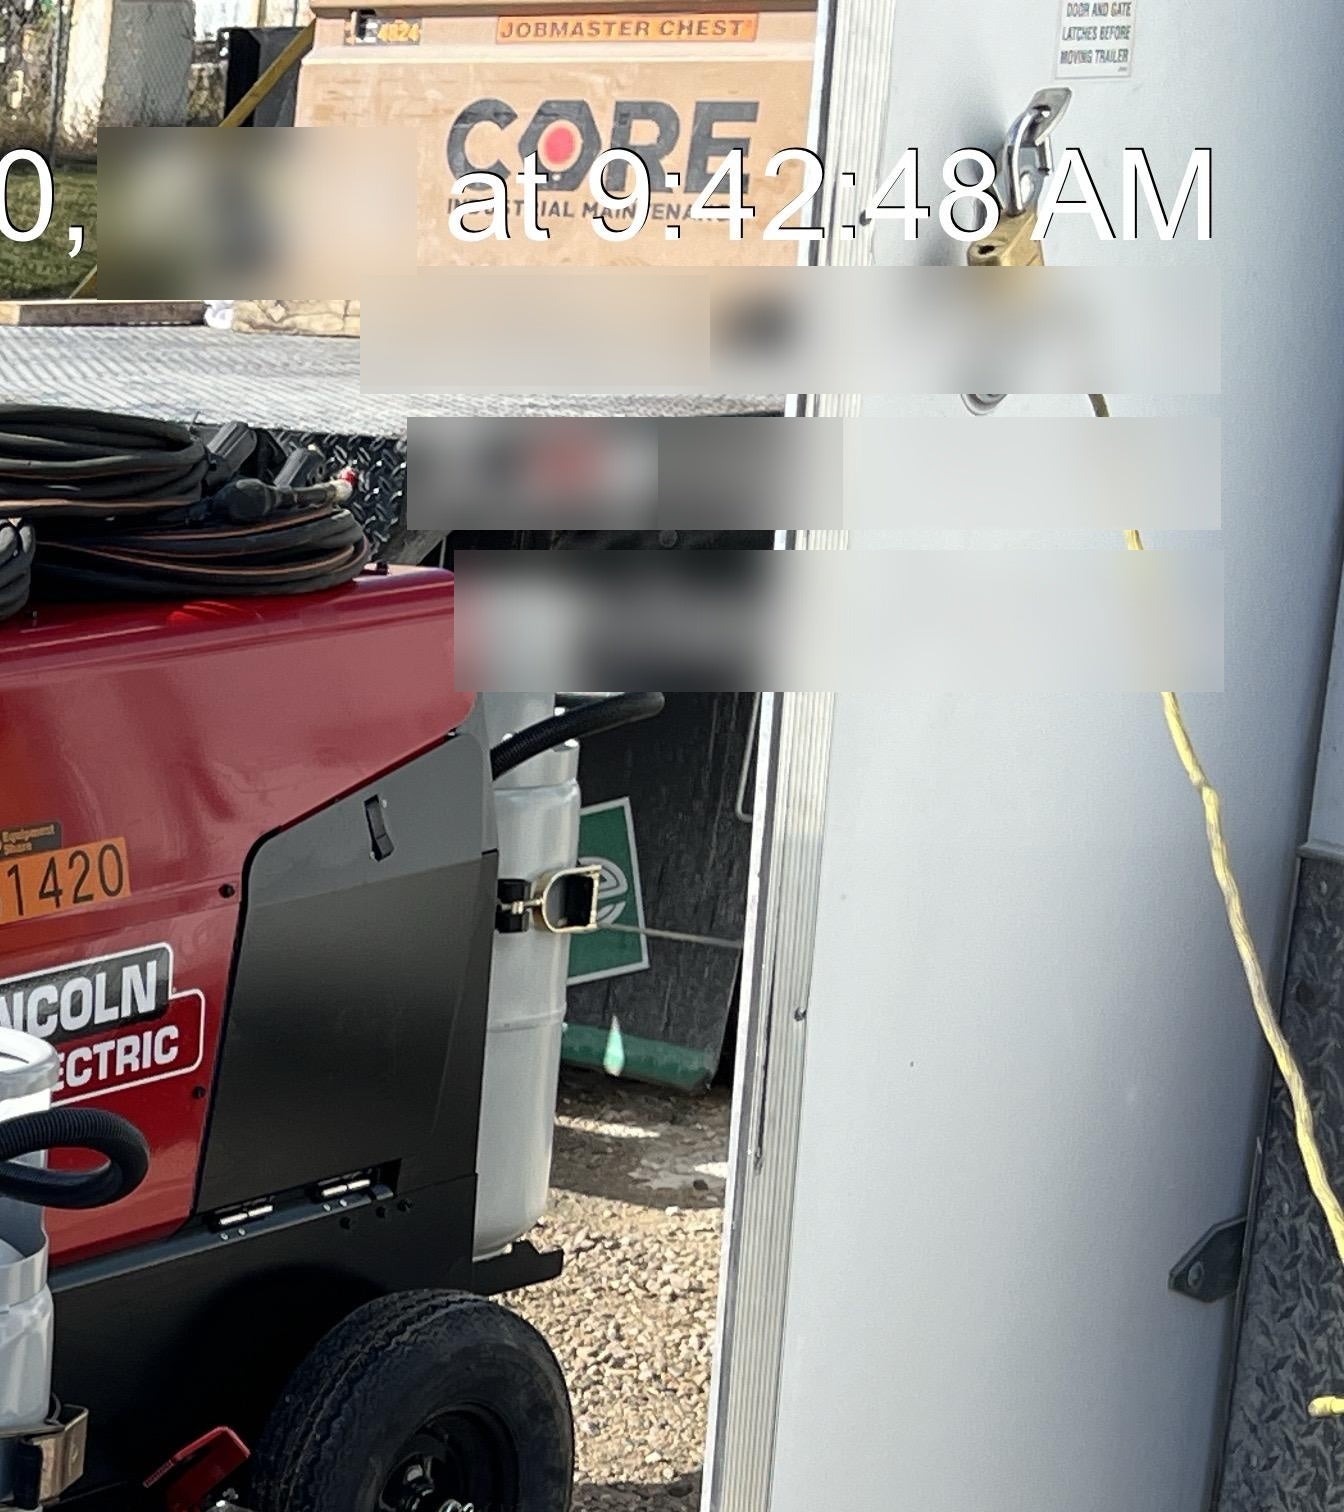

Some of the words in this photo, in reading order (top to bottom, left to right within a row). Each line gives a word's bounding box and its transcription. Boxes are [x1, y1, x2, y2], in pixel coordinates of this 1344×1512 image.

[500, 21, 651, 38] JOBMASTER
[660, 19, 744, 37] CHEST
[446, 97, 760, 194] CORE
